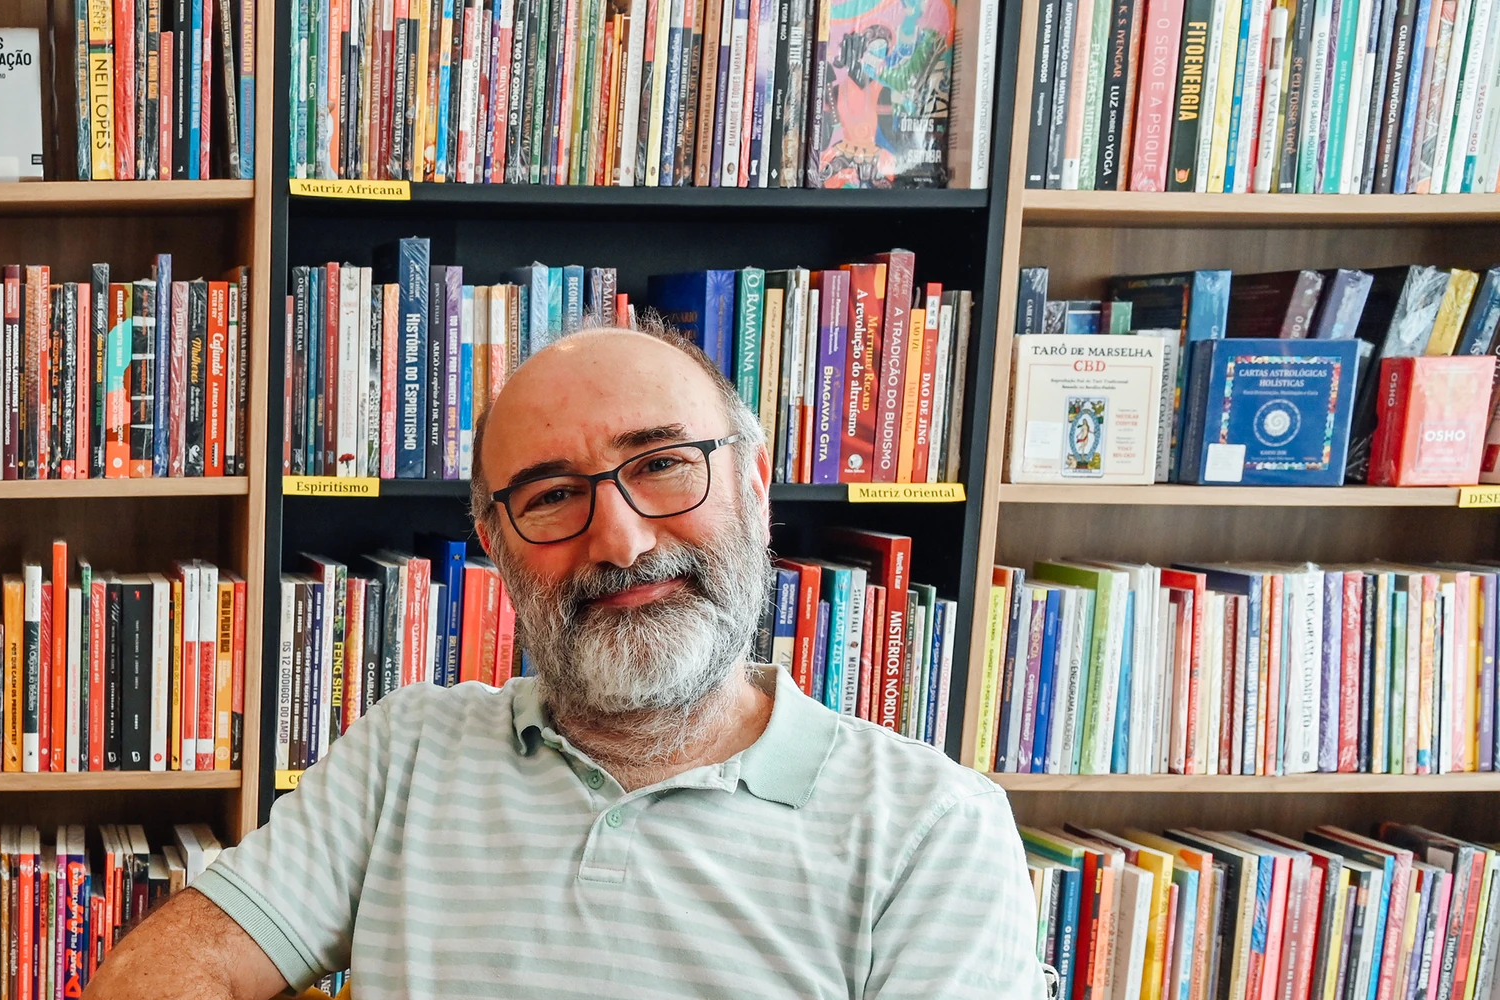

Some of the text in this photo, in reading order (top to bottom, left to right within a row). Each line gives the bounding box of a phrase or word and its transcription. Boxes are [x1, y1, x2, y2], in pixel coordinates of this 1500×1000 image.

[1040, 3, 1053, 83] YOGA PARA NERVOSOS
[1056, 2, 1073, 125] AUTOPERFEIÇÃO COM HATHA YOGA
[1113, 30, 1125, 78] IYENGAR
[1179, 22, 1207, 121] FITOENERGIA
[1388, 25, 1408, 124] CULINÁRIA AYURVÉDICA
[95, 59, 110, 150] NEI LOPES
[1106, 110, 1118, 133] SOBRE
[1108, 86, 1120, 107] LUZ
[1143, 18, 1170, 172] O SEXO E A PSIQUE
[300, 183, 404, 195] Matriz Africana
[1103, 144, 1115, 176] YOGA
[211, 333, 225, 377] Cafundó
[743, 275, 759, 372] O RAMAYANA
[1031, 344, 1153, 358] TARÔ DE MARSELHA
[403, 314, 421, 450] HISTÓRIA DO ESPIRITISMO
[847, 289, 868, 437] A revolução do altruísmo
[862, 315, 878, 410] MATTHIEU RICARD
[881, 307, 903, 470] A TRADIÇÃO DO BUDISMO
[1073, 358, 1106, 373] CBD
[1239, 368, 1327, 379] CARTAS ASTROLÓGICAS
[1259, 377, 1304, 388] HOLÍSTICAS
[1388, 372, 1399, 407] OSHO
[211, 407, 218, 415] NO
[818, 366, 833, 462] BHAGAVAD GITA
[917, 373, 931, 445] DAO DE JING
[1423, 429, 1466, 444] OSHO
[296, 482, 369, 493] Espiritismo
[859, 487, 955, 498] Matriz Oriental
[332, 641, 343, 707] FENG SHUI
[886, 611, 902, 675] MISTÉRIOS
[279, 641, 291, 744] OS 12 CÓDIGOS DO AMOR
